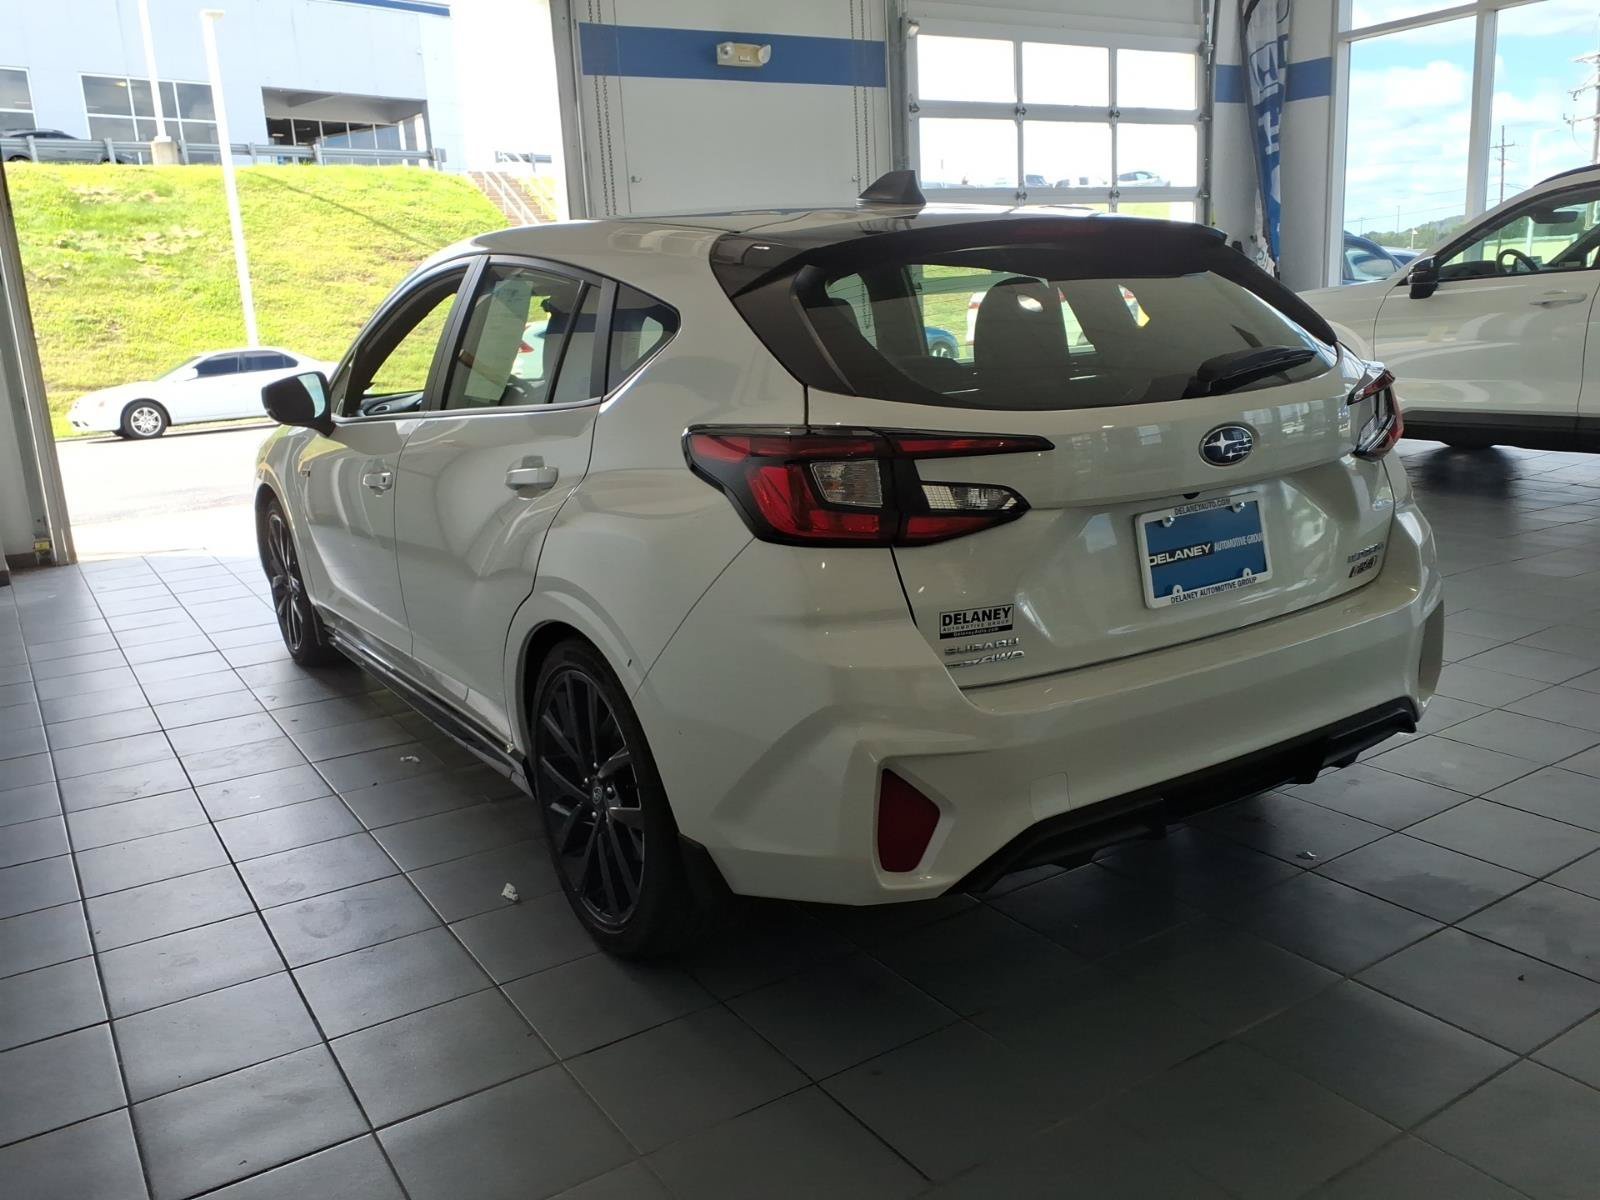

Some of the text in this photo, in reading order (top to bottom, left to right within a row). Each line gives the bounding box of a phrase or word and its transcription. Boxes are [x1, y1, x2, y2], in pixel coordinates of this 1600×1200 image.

[1149, 543, 1212, 566] DELANEY
[1171, 576, 1258, 604] DELANEY AUTOMOTIVE GROUP
[942, 606, 1012, 627] DELANEY
